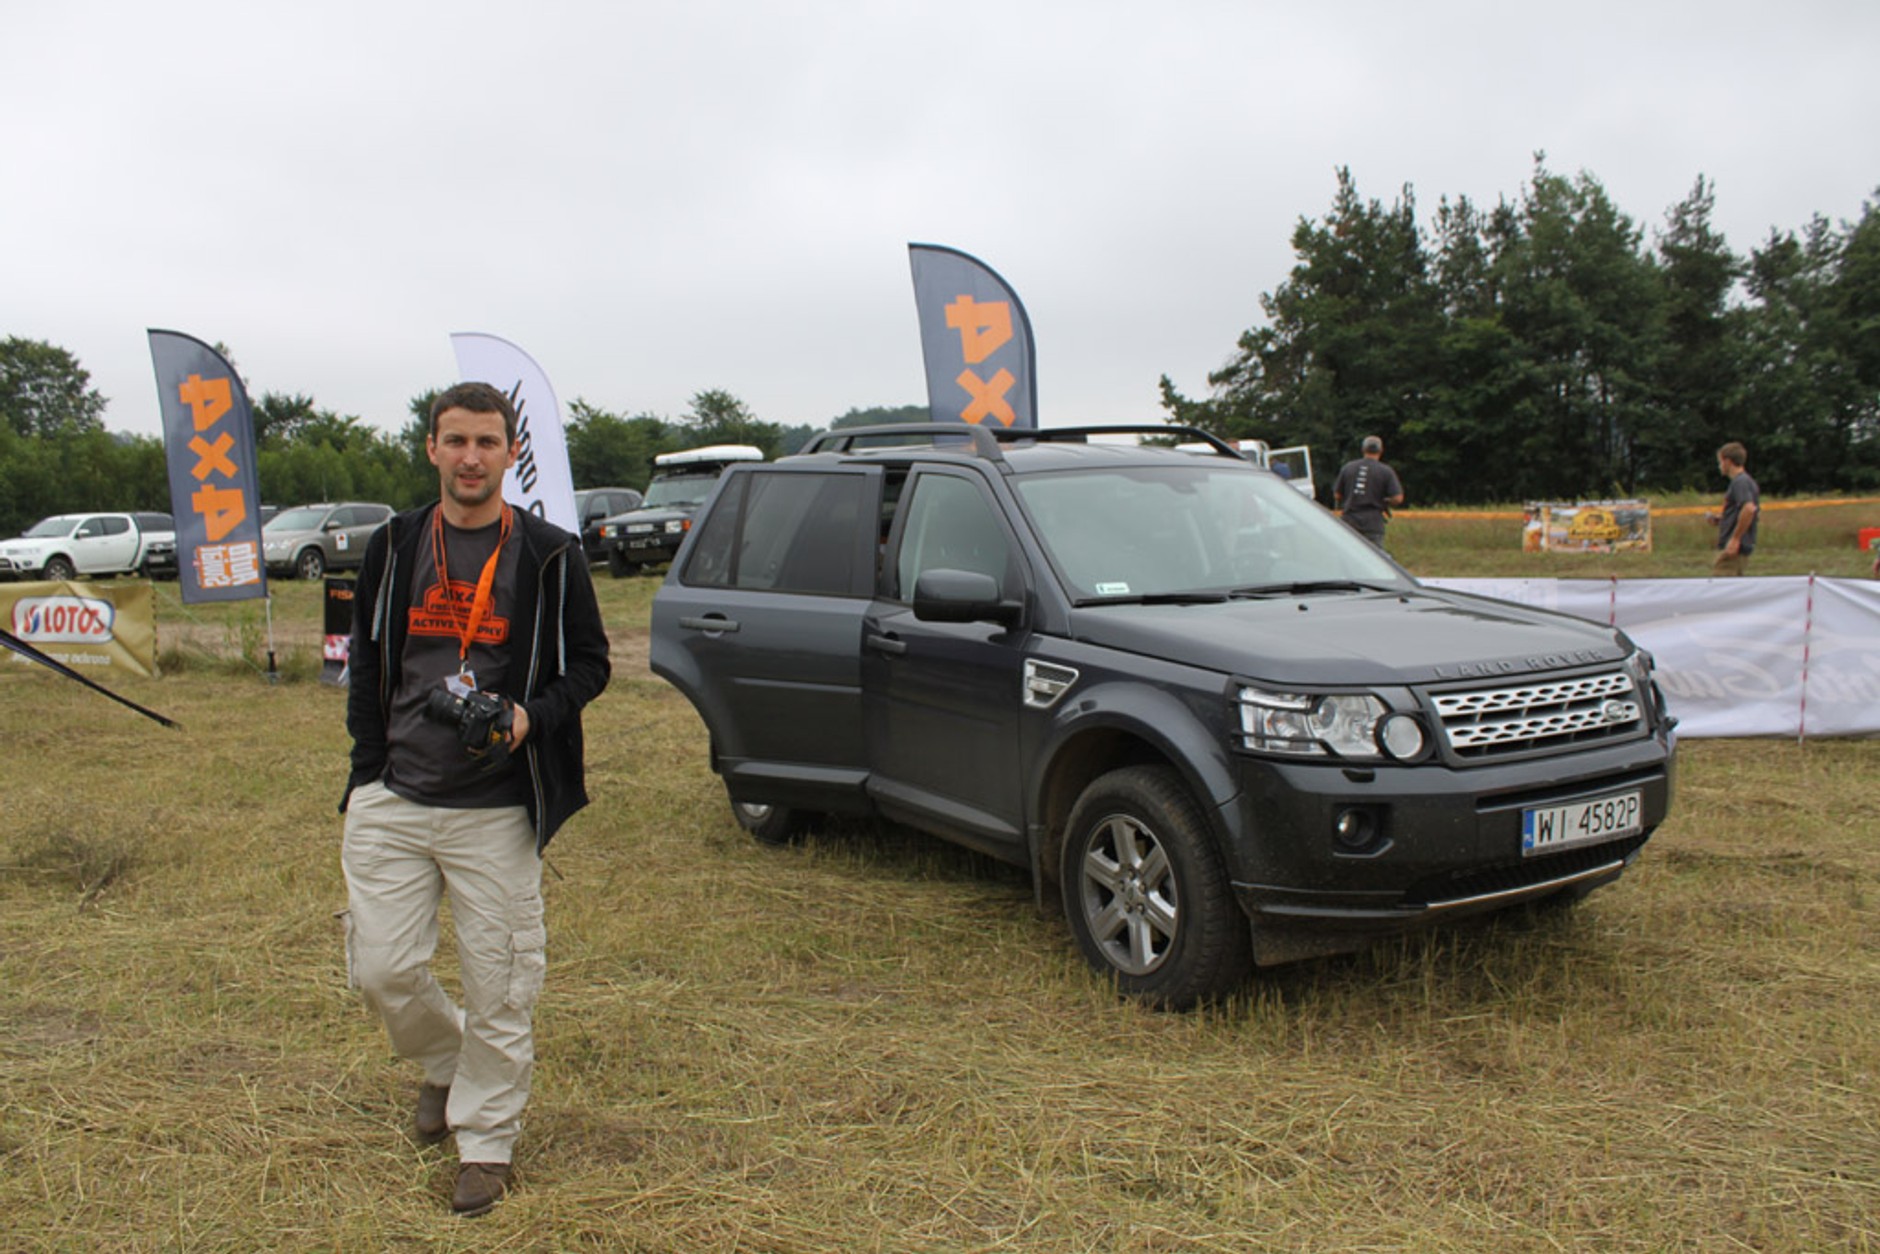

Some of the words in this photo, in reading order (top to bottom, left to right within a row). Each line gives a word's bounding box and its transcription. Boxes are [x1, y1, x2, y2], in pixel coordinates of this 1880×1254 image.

[44, 606, 105, 634] LOTOS
[412, 618, 455, 628] ACTIVE
[1433, 660, 1514, 680] LAND
[1525, 649, 1604, 672] ROVER
[1538, 809, 1566, 843] WI
[1579, 796, 1638, 835] 4582P
